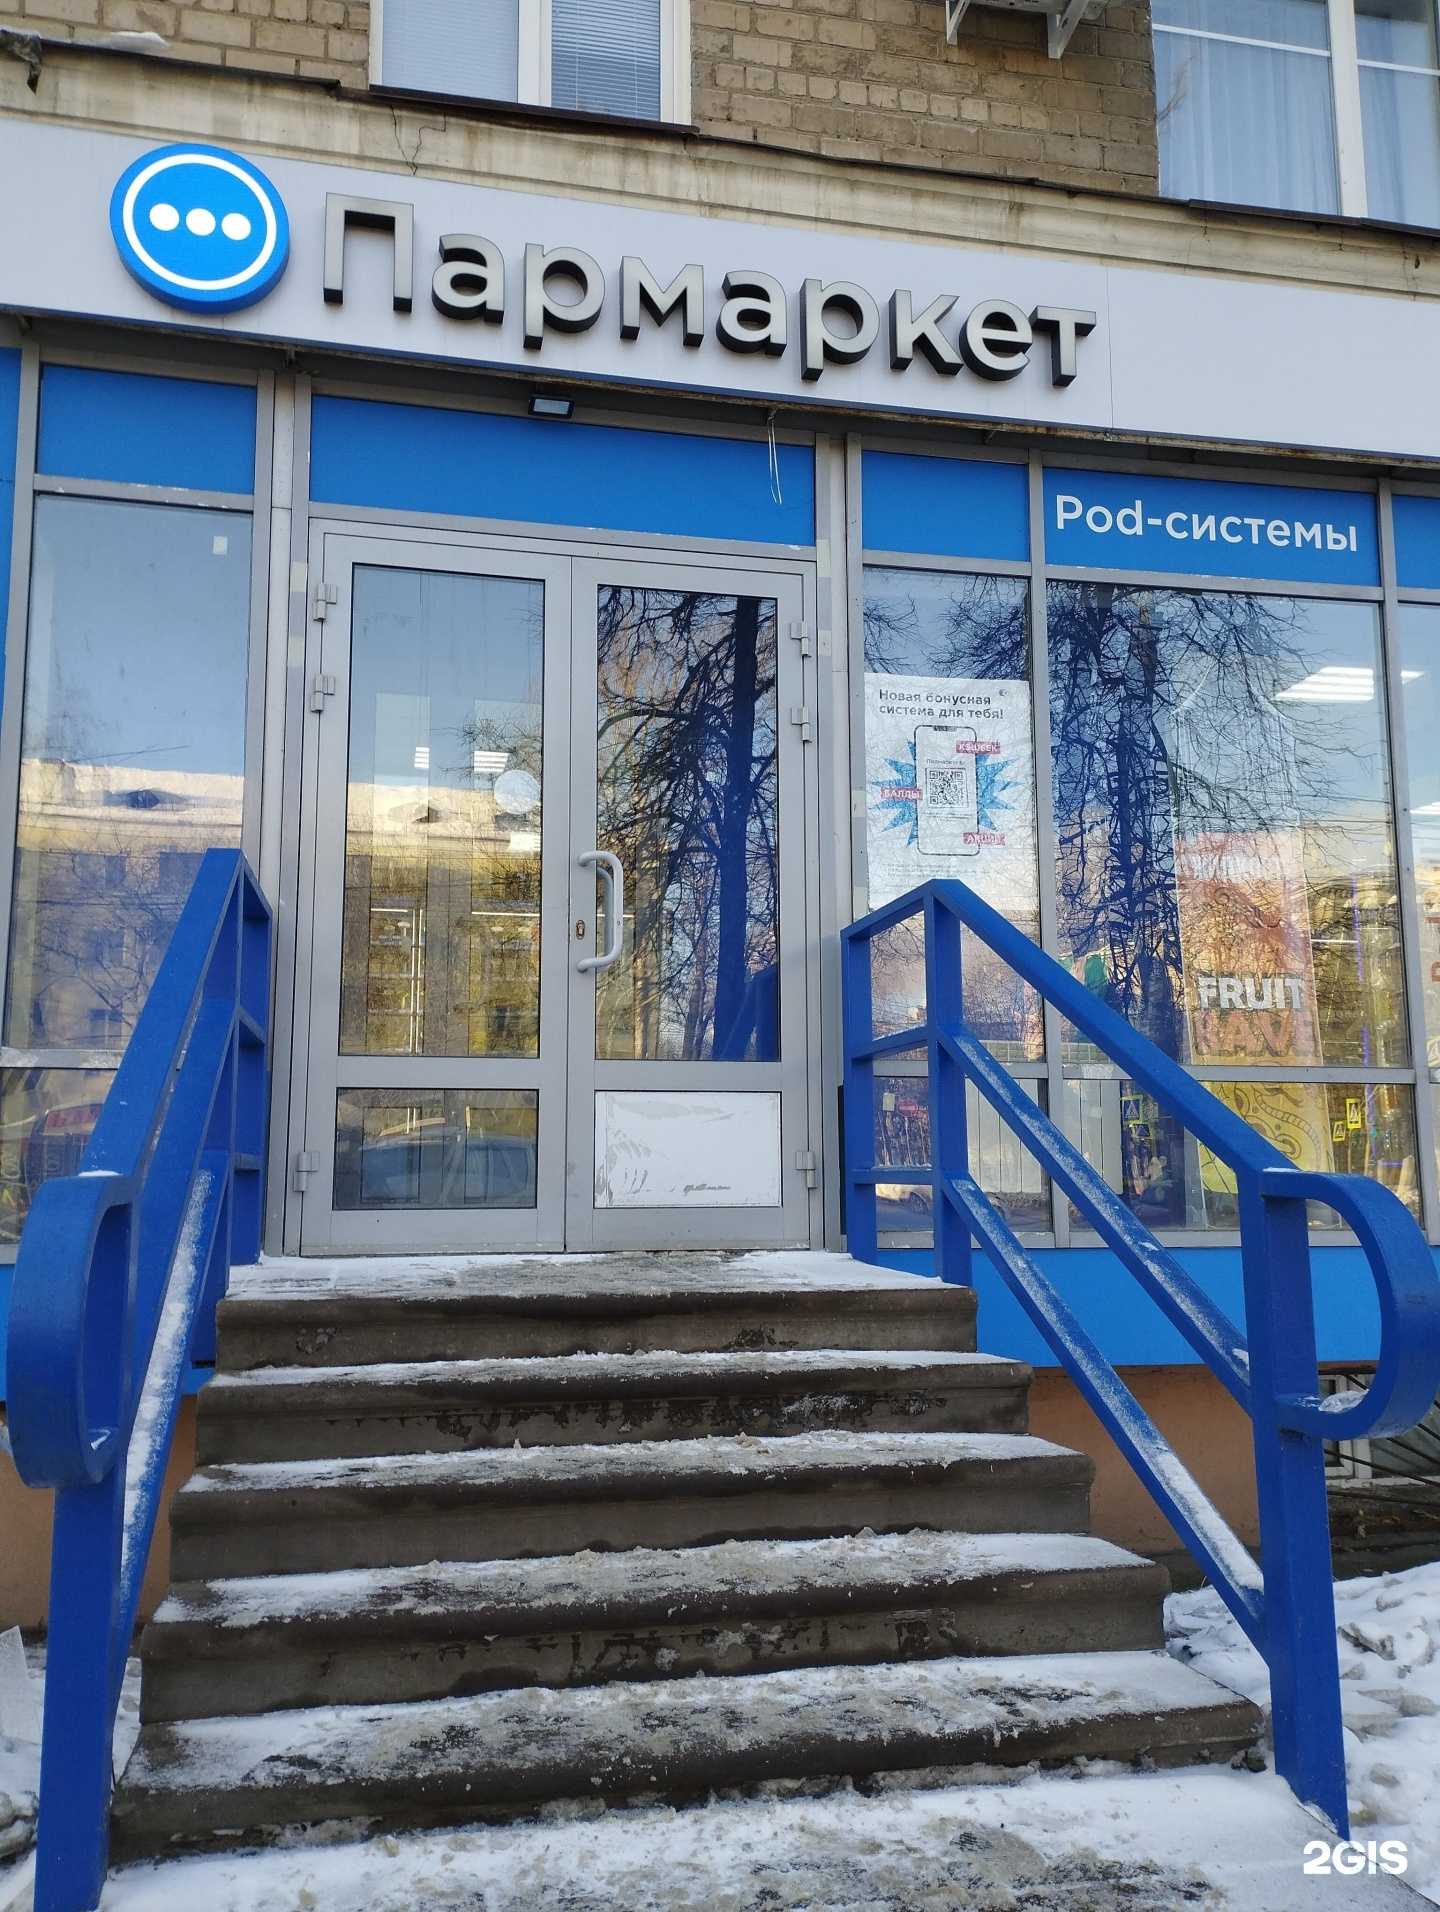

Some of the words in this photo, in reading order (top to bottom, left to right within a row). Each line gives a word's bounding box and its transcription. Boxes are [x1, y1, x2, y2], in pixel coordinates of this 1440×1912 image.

[323, 191, 1097, 387] Пармаркет
[1056, 494, 1357, 552] Pod-системы
[879, 688, 922, 703] Новая
[926, 691, 991, 706] бонусная
[879, 705, 935, 717] система
[938, 709, 964, 719] для
[968, 708, 1004, 720] тебя!
[1198, 976, 1305, 1009] FRUIT
